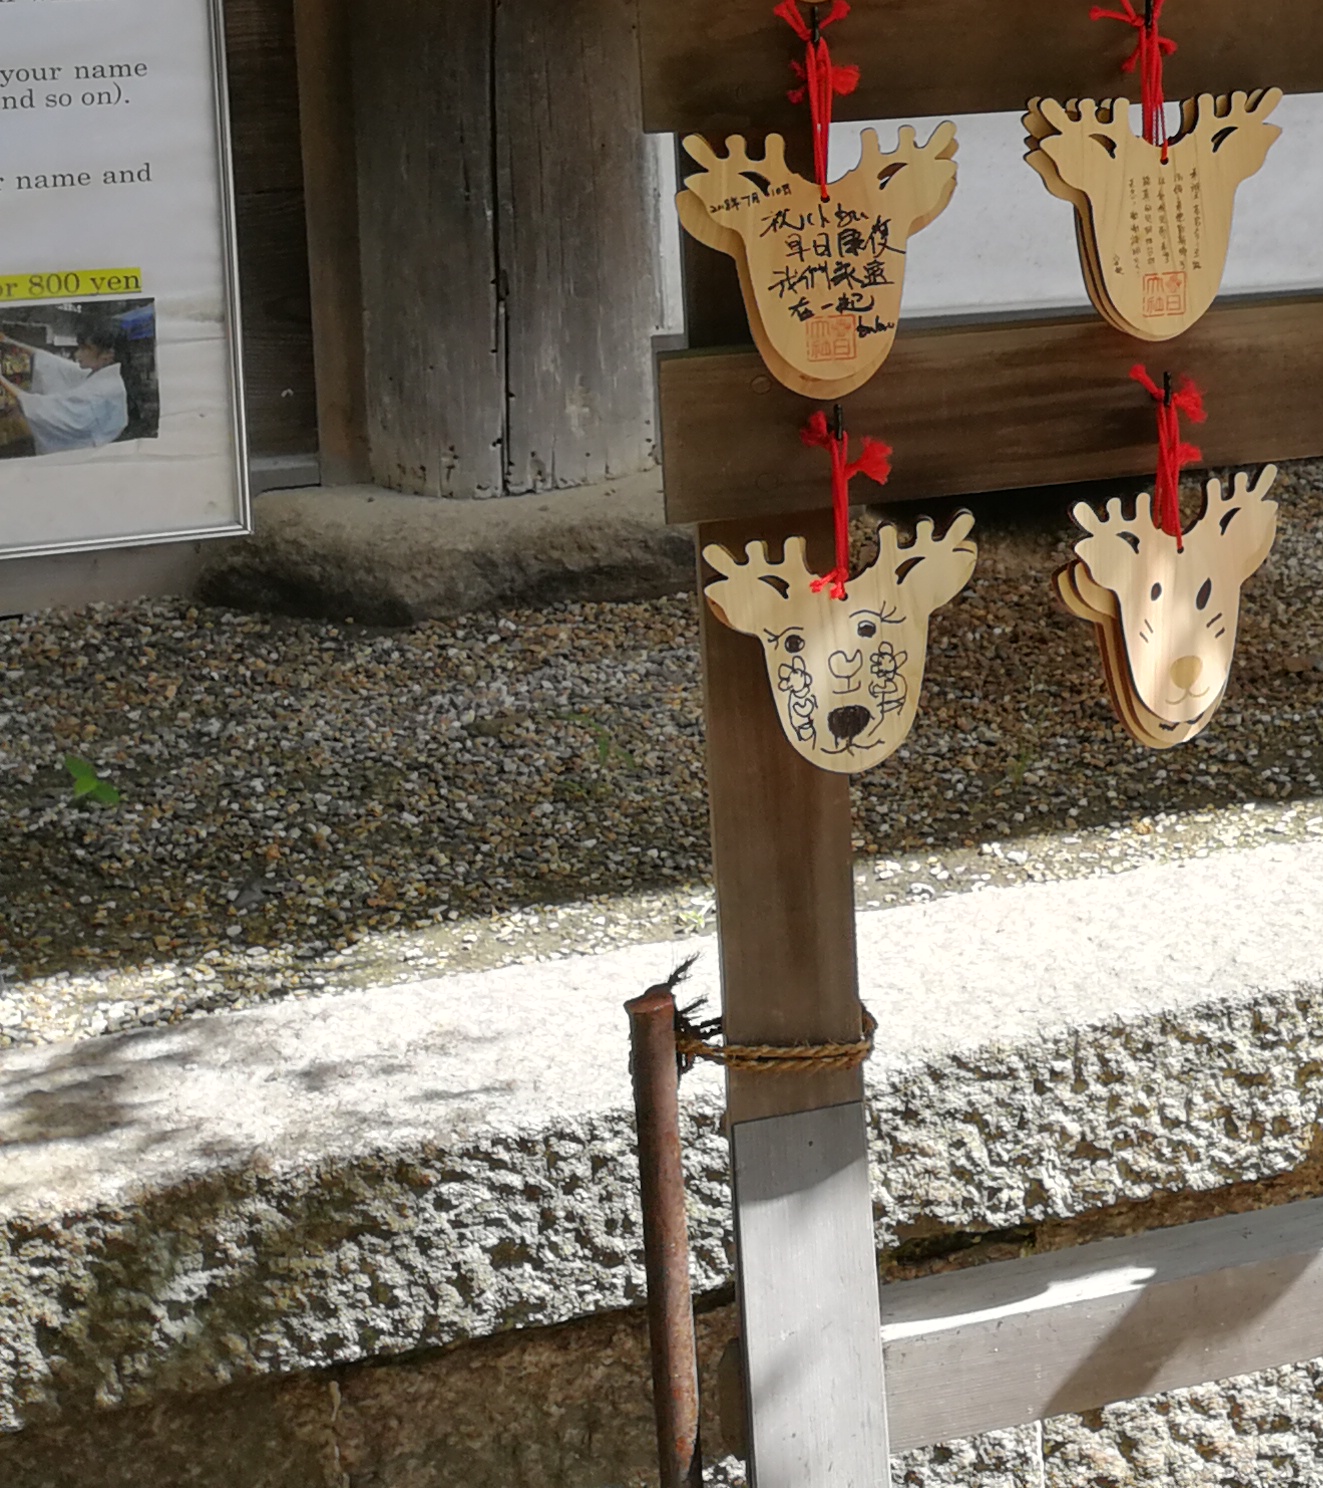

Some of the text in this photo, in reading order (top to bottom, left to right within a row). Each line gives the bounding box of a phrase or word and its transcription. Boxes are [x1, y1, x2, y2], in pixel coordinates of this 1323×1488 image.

[0, 63, 148, 88] your name
[0, 81, 130, 110] nd so on).
[16, 172, 91, 190] name
[103, 162, 152, 185] and
[28, 272, 80, 296] 800
[90, 274, 141, 296] yen
